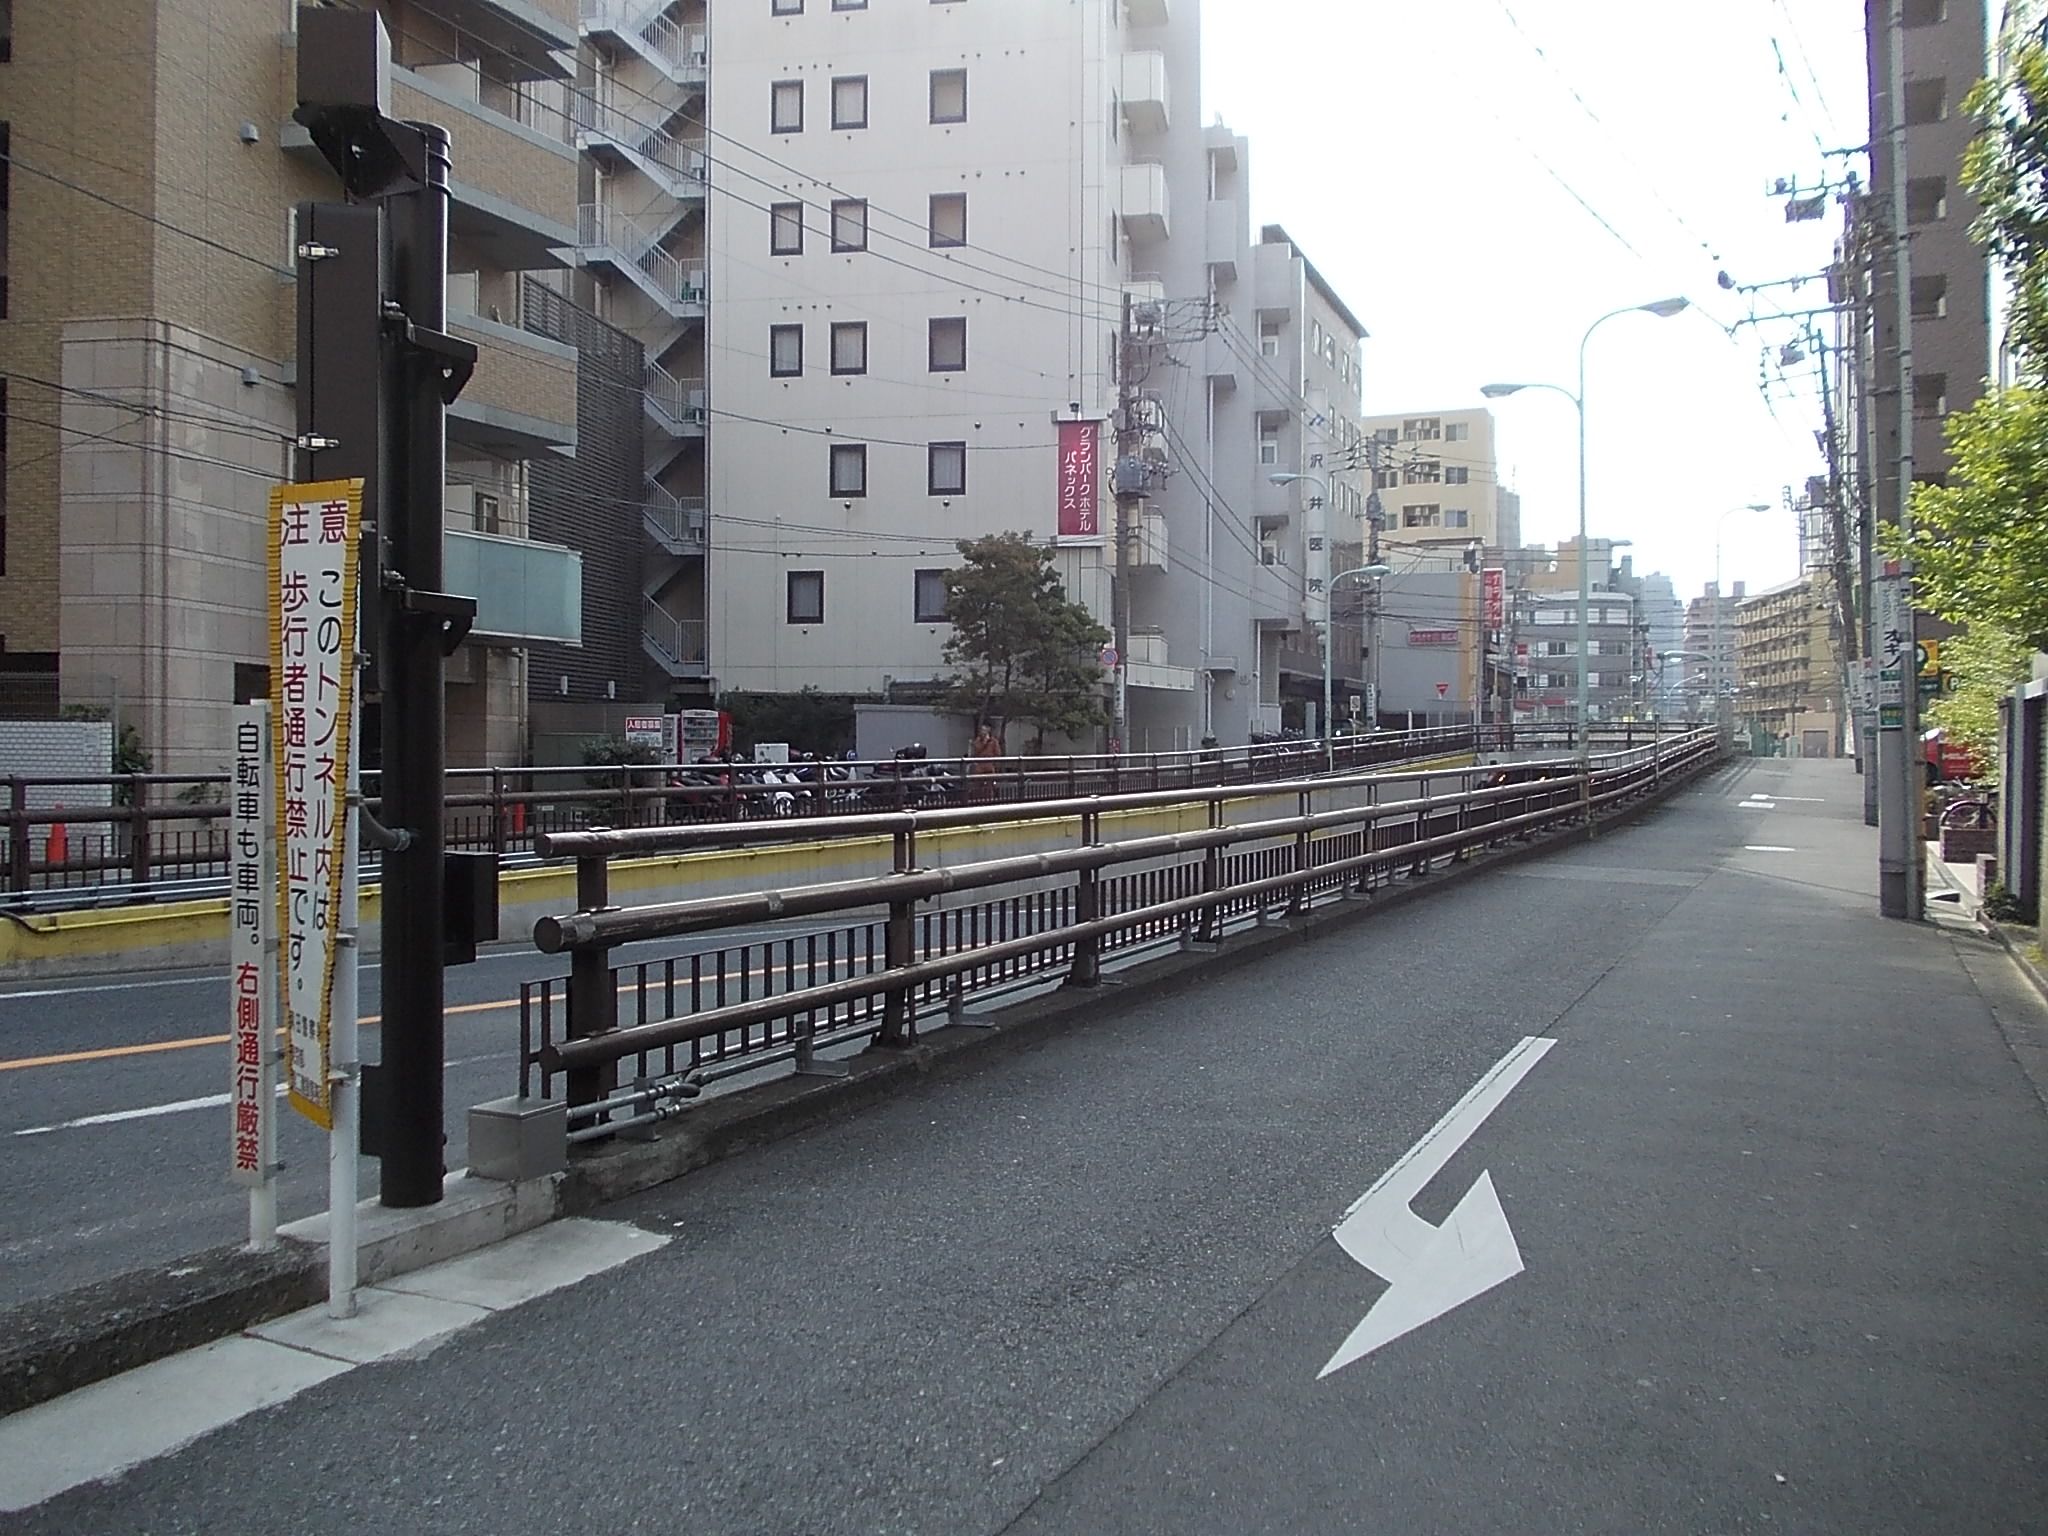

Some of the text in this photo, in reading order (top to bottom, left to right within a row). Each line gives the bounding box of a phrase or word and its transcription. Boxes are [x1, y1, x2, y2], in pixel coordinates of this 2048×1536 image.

[1080, 426, 1093, 531] グランパークホテル
[236, 720, 260, 1172] 自転車も車両。 右側通行厳禁
